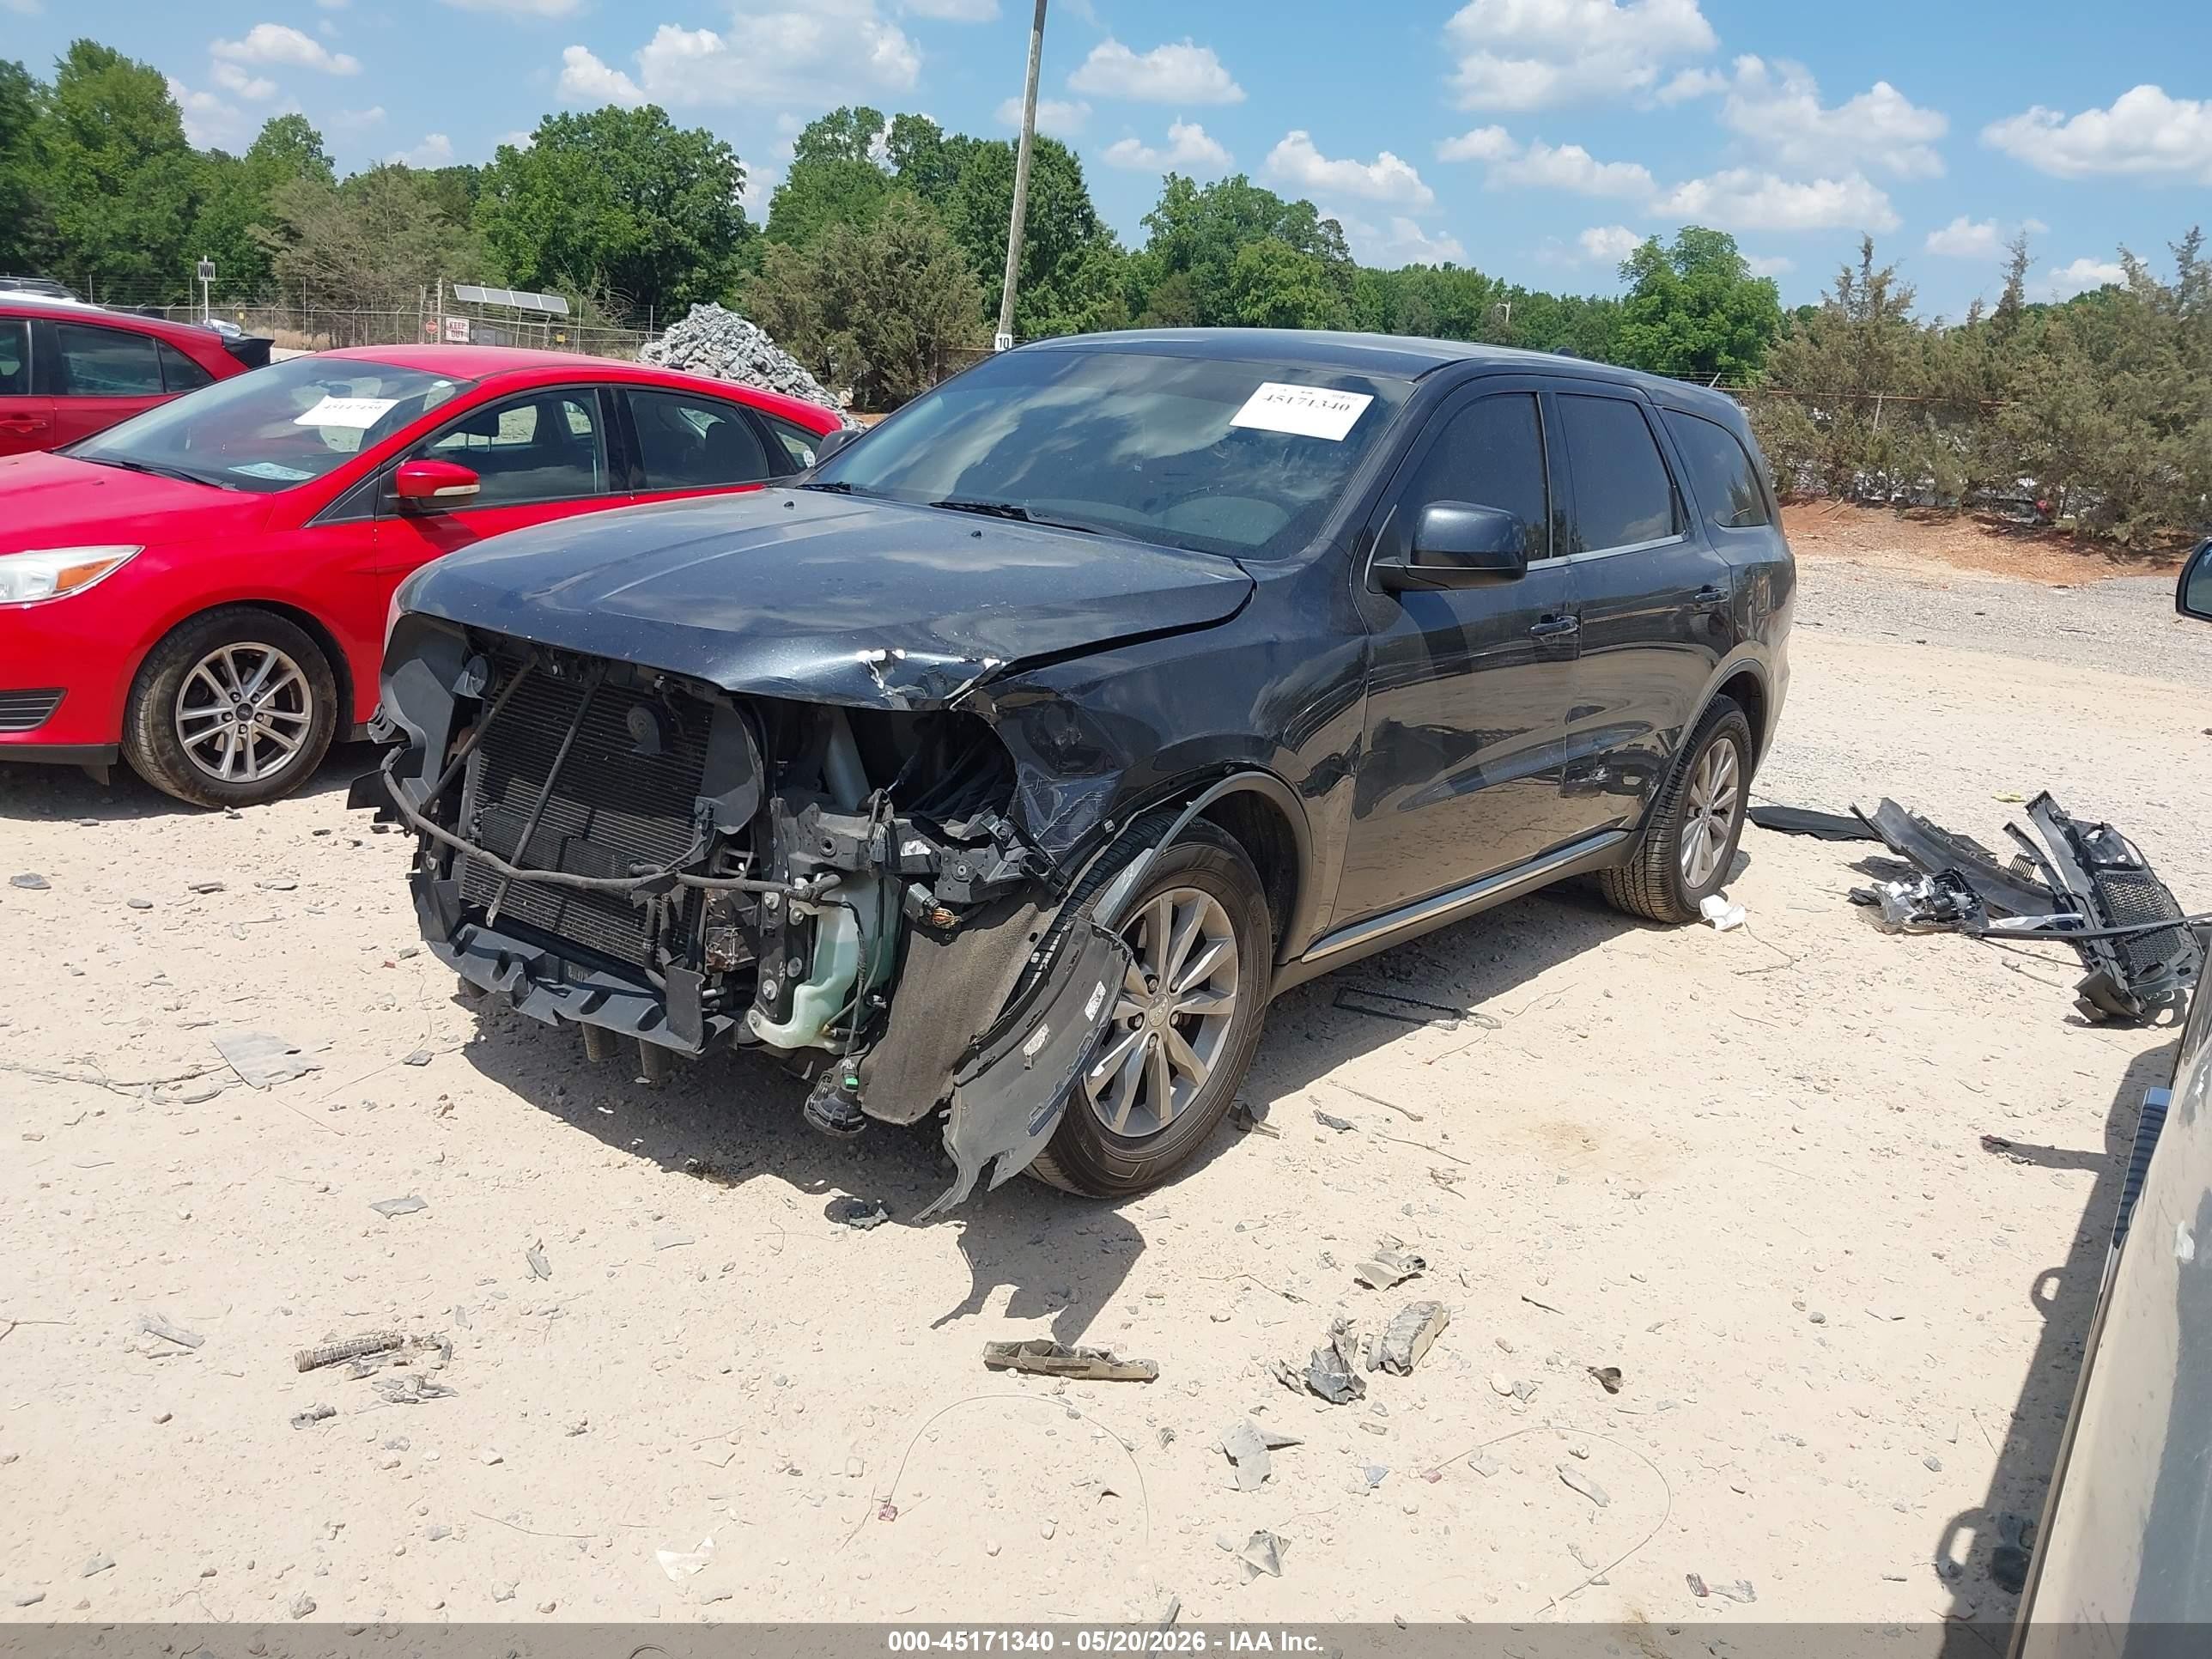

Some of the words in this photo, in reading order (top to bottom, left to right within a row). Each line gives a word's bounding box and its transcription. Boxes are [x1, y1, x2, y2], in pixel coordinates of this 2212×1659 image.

[199, 264, 214, 278] WW
[449, 321, 466, 330] KEEP
[451, 330, 464, 338] OUT
[998, 337, 1010, 349] 10
